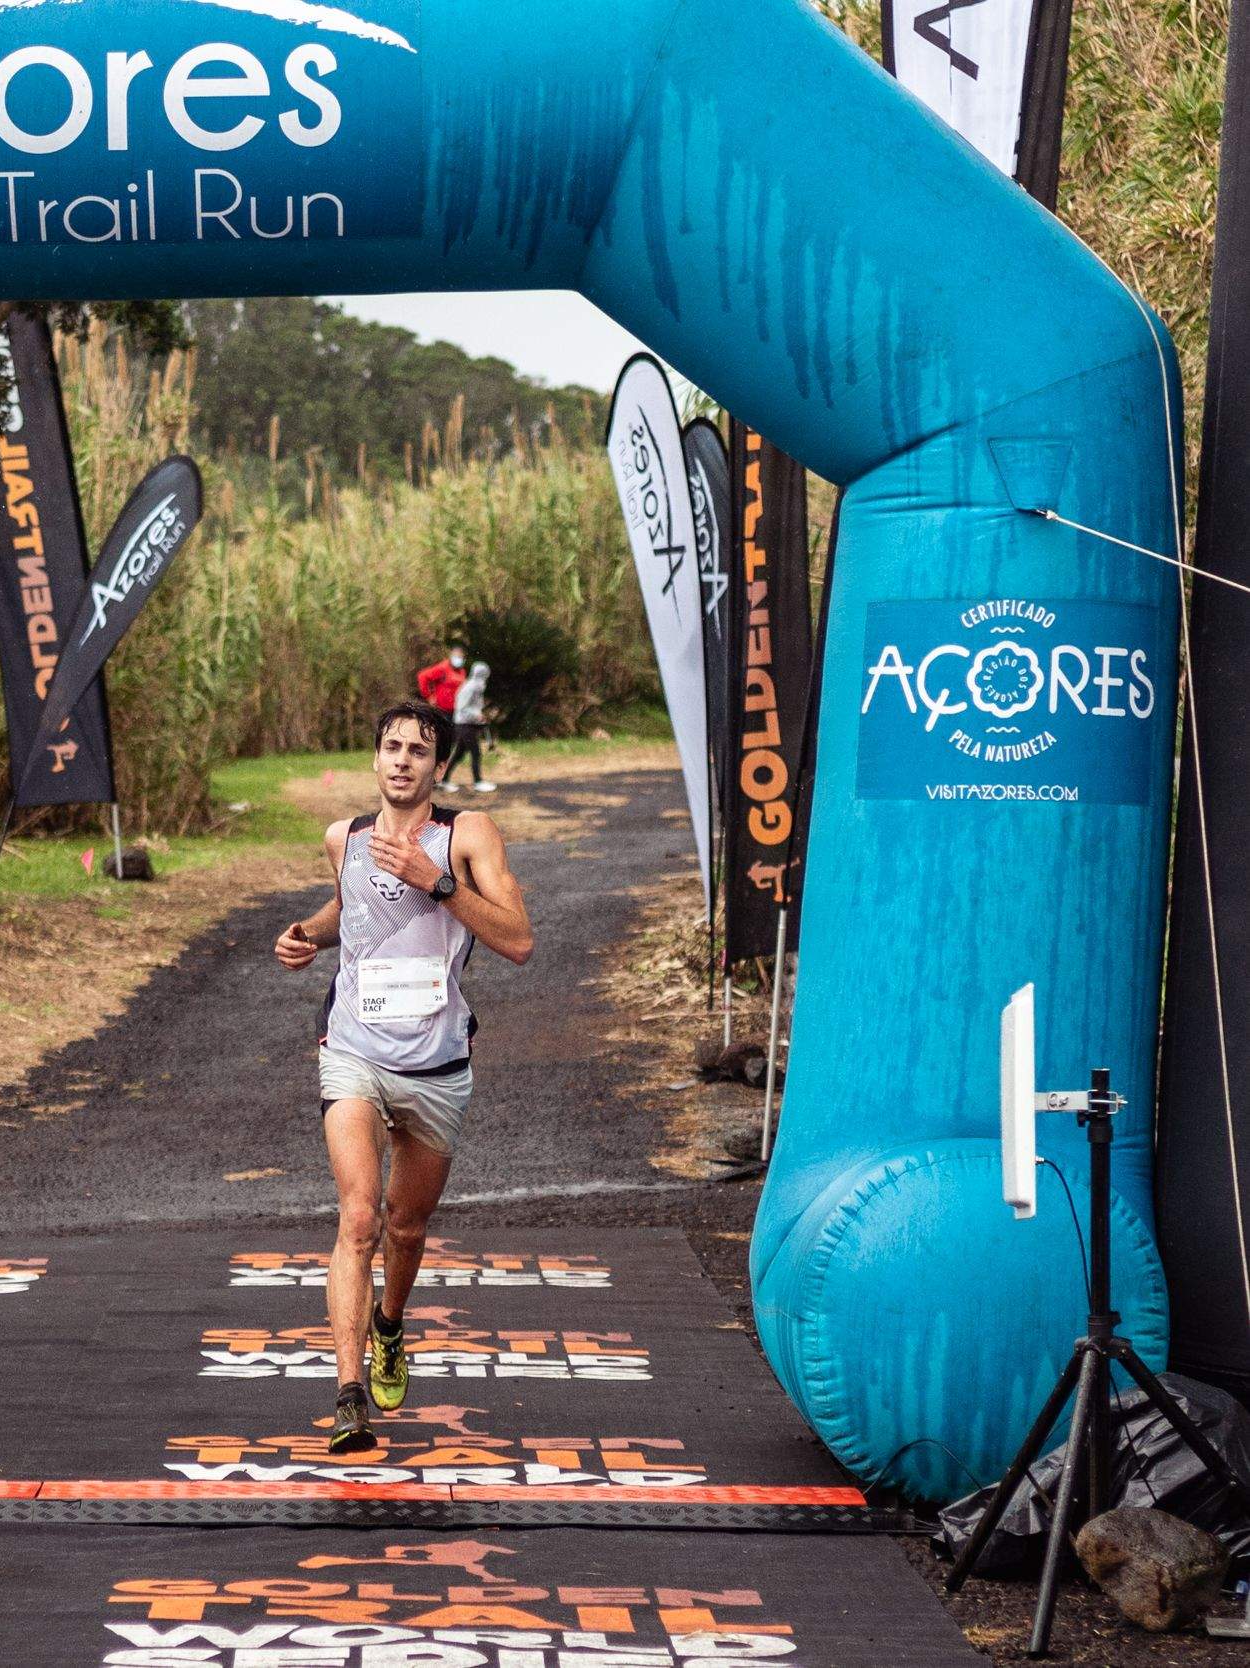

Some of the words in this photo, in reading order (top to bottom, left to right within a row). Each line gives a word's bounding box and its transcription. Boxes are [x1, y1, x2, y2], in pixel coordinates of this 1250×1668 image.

[196, 168, 344, 240] Run
[92, 506, 176, 629] Azores
[960, 599, 1057, 629] CERTIFICADO
[948, 729, 980, 759] PELA
[984, 730, 1058, 763] NATUREZA
[925, 784, 1079, 801] VISITAZORES.COM
[362, 997, 386, 1005] STAGE
[163, 1463, 707, 1486] WORLD
[113, 1580, 764, 1606] GOLDEN
[107, 1595, 794, 1635] TRAIL
[103, 1624, 797, 1658] WORLD
